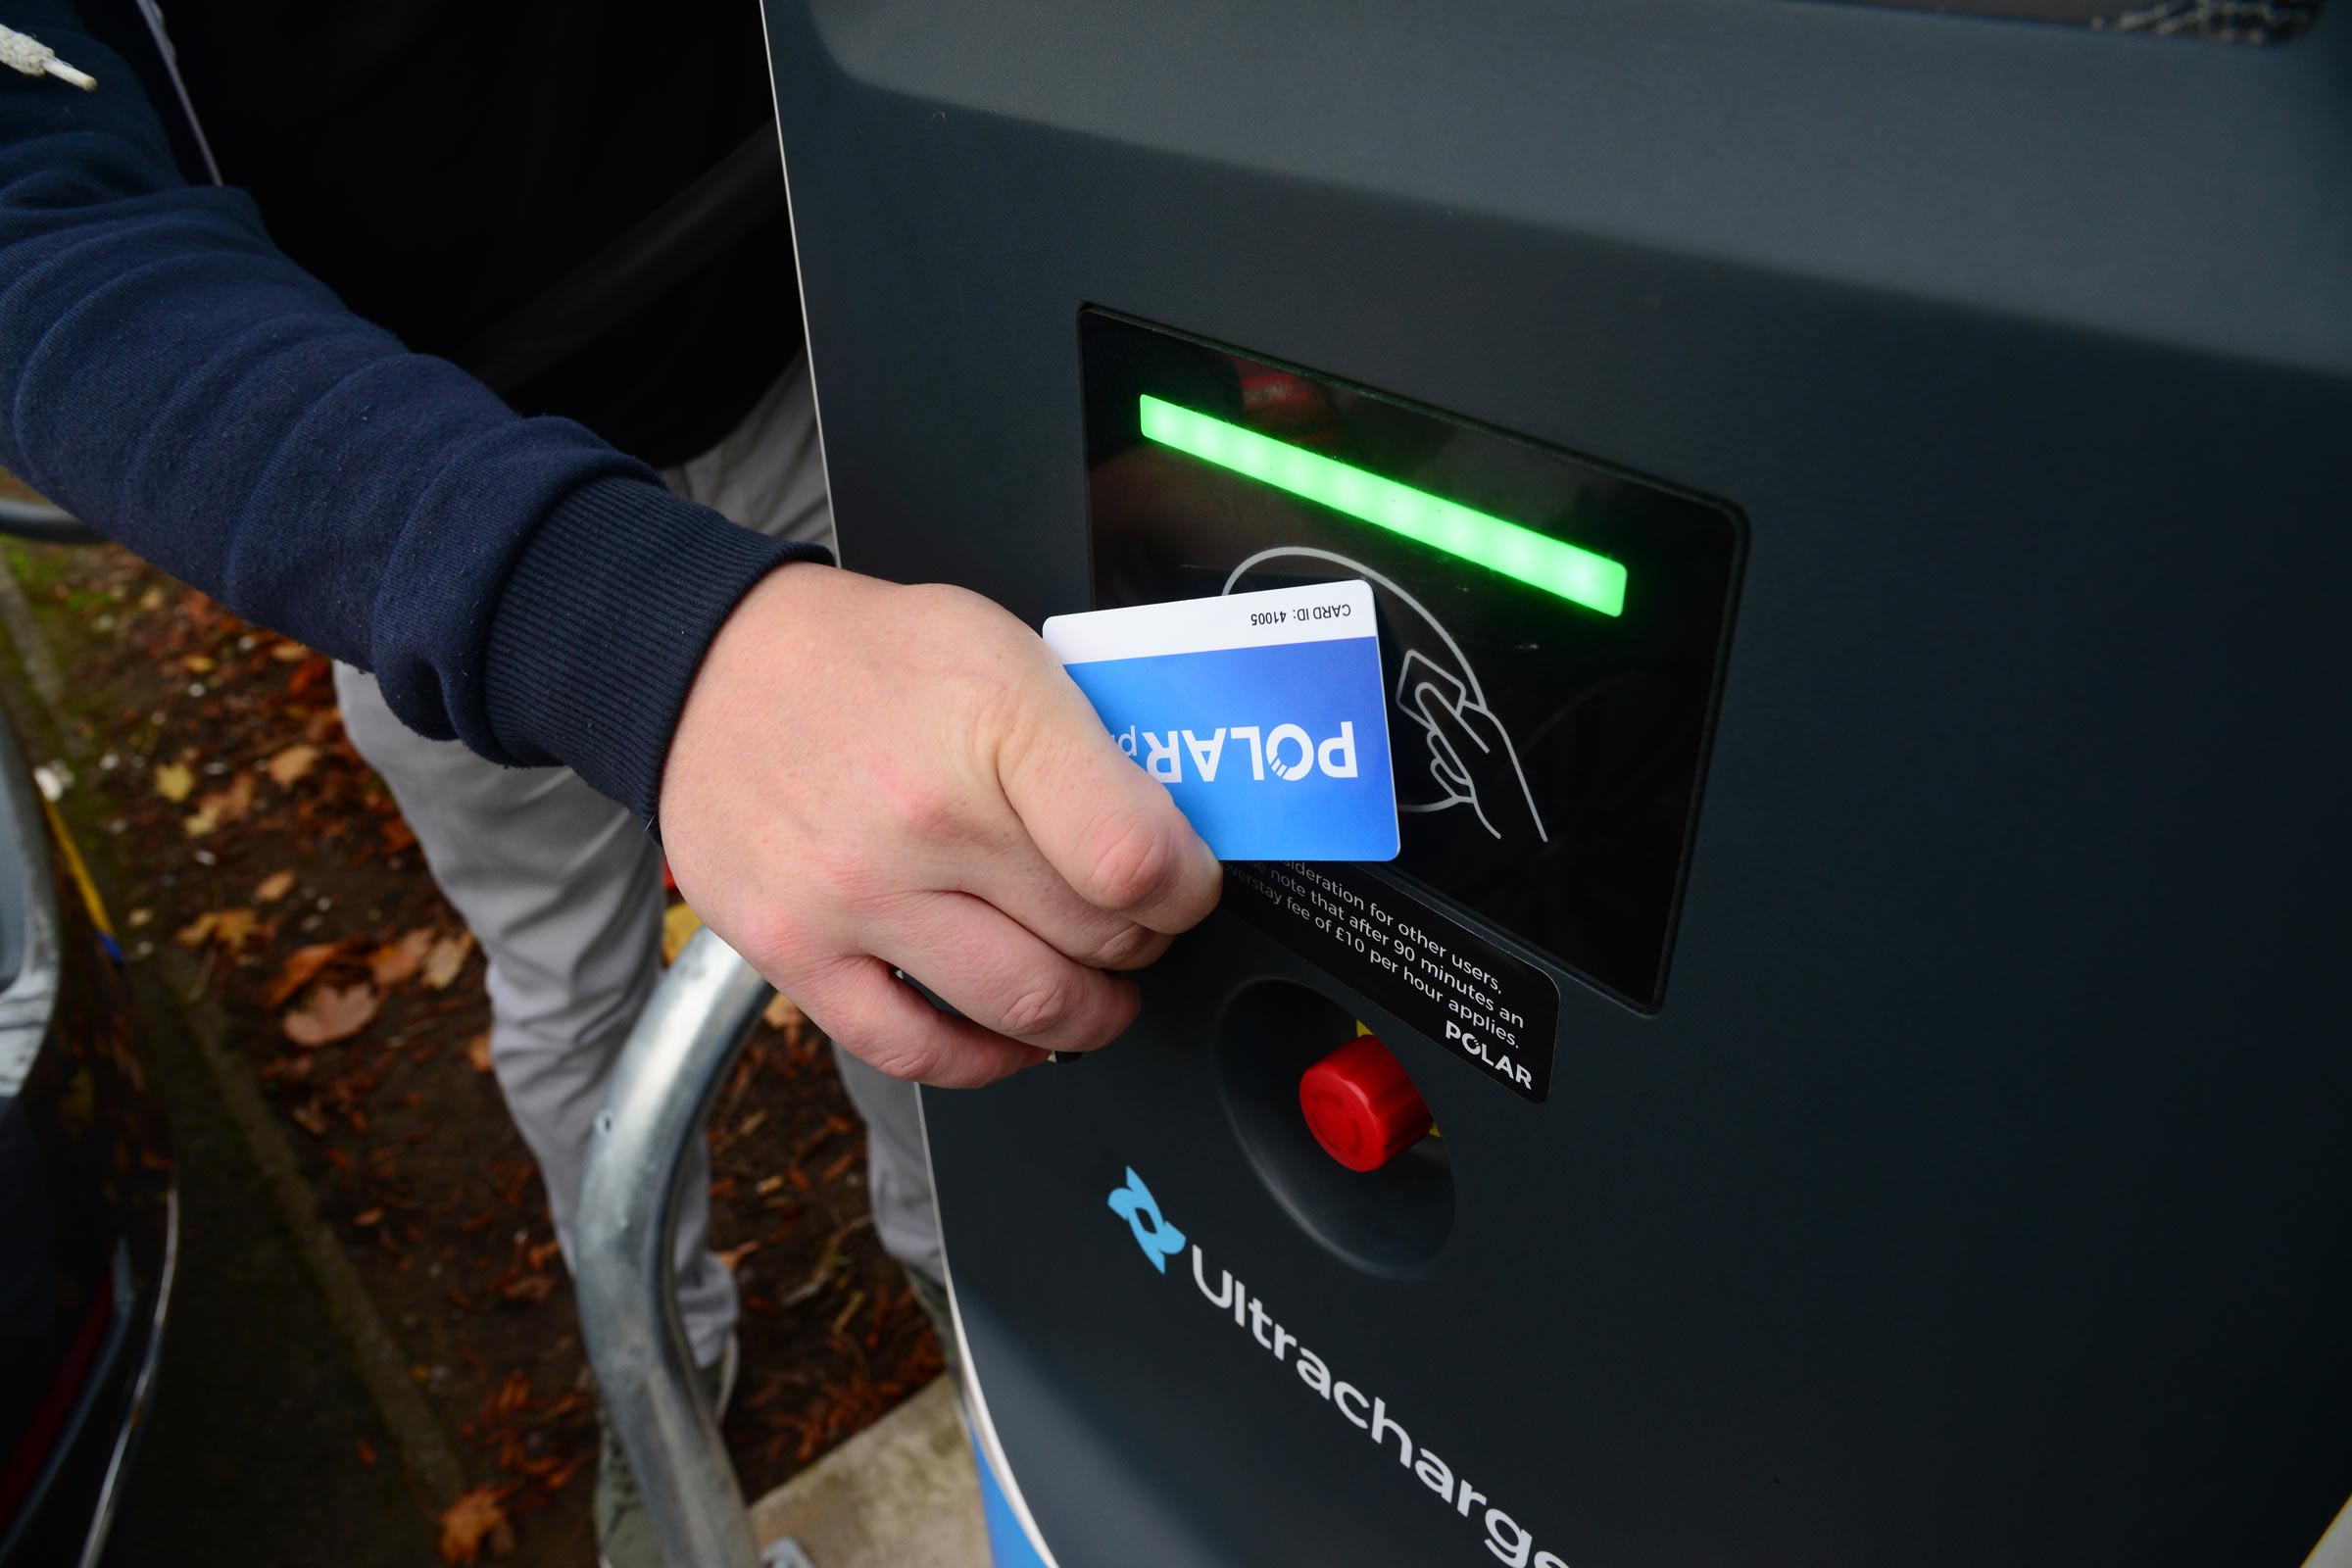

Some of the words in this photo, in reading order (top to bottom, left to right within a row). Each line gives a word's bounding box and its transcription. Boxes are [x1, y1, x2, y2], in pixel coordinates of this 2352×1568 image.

[1250, 611, 1287, 626] 41005
[1293, 608, 1310, 621] ID:
[1311, 604, 1351, 620] CARD
[1270, 868, 1306, 898] note
[1310, 890, 1345, 921] that
[1348, 915, 1390, 946] after
[1394, 939, 1415, 962] 90
[1421, 957, 1494, 1011] minutes
[1498, 1007, 1524, 1029] an
[1287, 896, 1310, 920] fee
[1314, 916, 1332, 934] of
[1335, 926, 1365, 953] £10
[1370, 949, 1399, 973] per
[1403, 965, 1444, 1003] hour
[1447, 999, 1519, 1049] applies.
[1370, 903, 1394, 926] for
[1397, 923, 1447, 957] other
[1451, 954, 1502, 995] users,
[1445, 1019, 1532, 1091] POLAR
